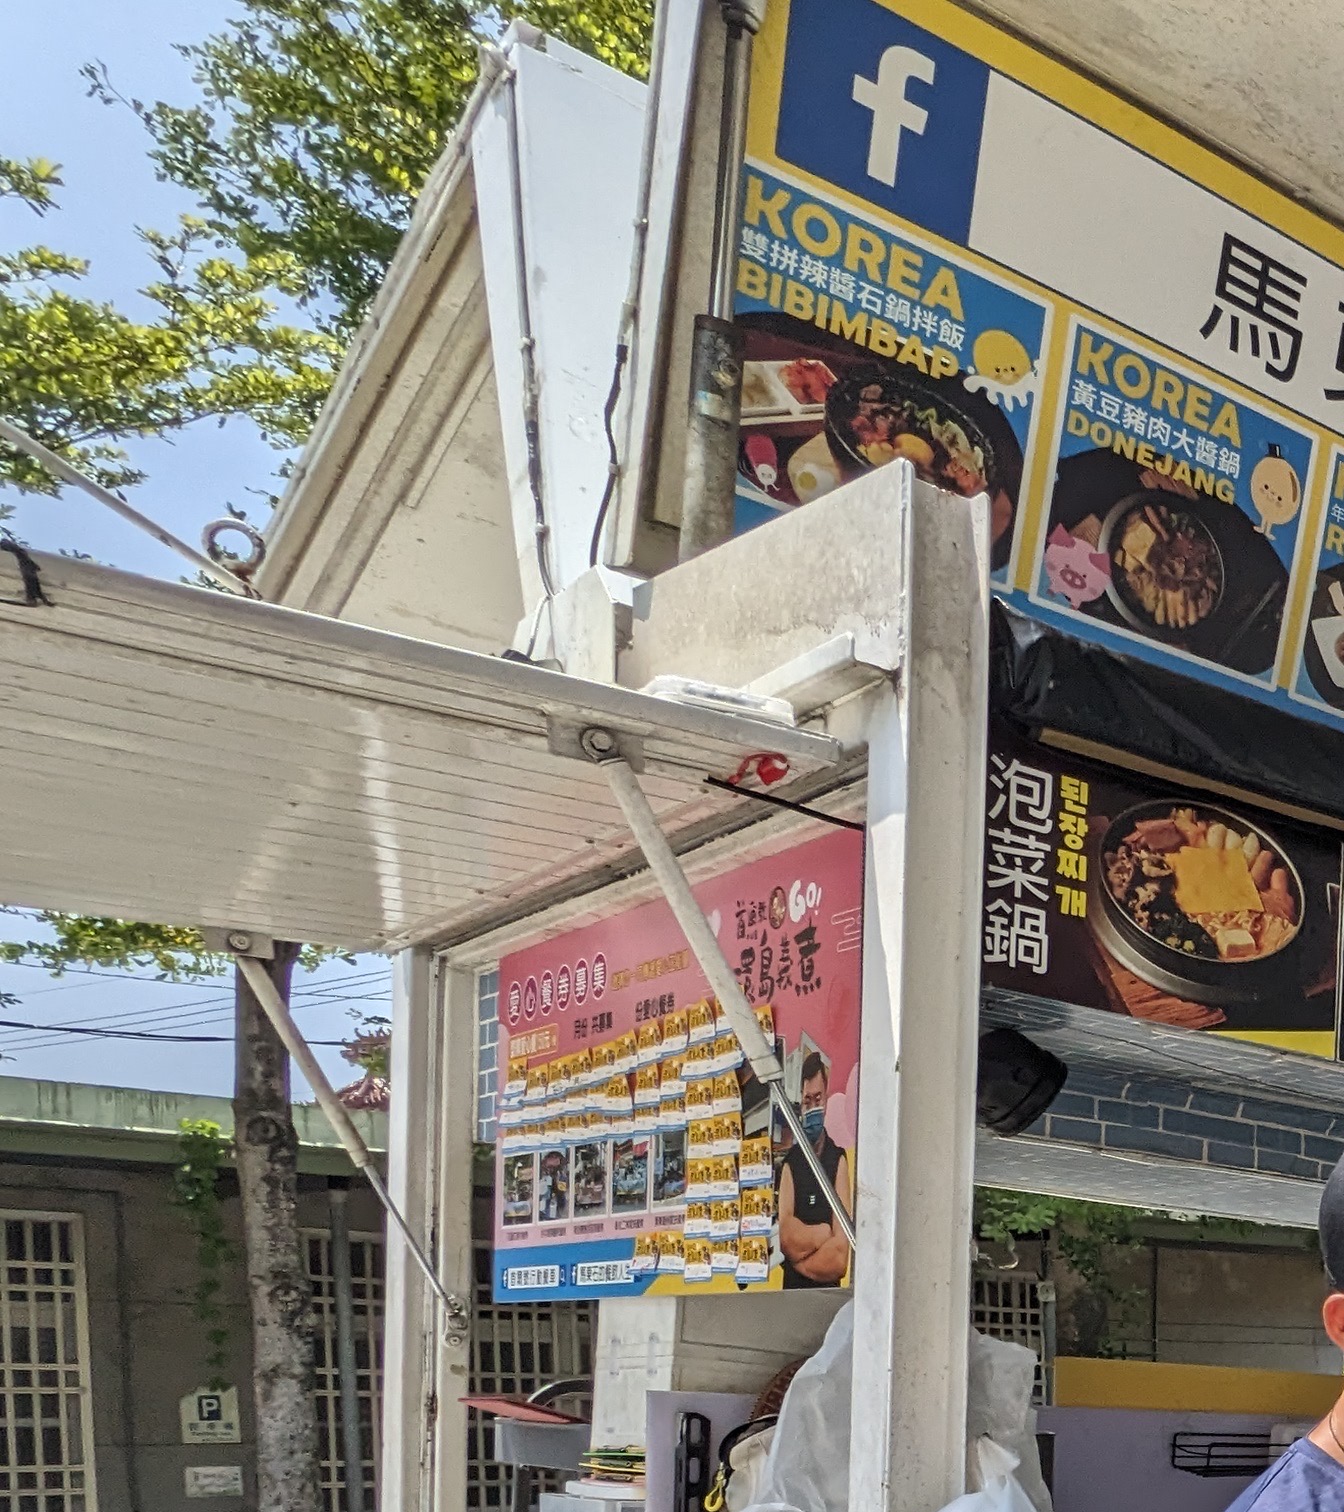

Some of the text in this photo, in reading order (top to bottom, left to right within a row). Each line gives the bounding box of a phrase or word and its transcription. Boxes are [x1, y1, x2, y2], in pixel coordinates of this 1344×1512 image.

[740, 226, 966, 352] 雙拼辣醬石鍋拌飯
[744, 175, 965, 322] KOREA
[737, 257, 960, 380] BIBIMBAP
[1076, 331, 1242, 449] KOREA
[1066, 408, 1236, 506] DONEJANG
[789, 879, 823, 923] GO!
[983, 752, 1053, 977] 泡菜鍋
[1054, 774, 1090, 919] 된장찌개
[200, 1397, 220, 1419] P
